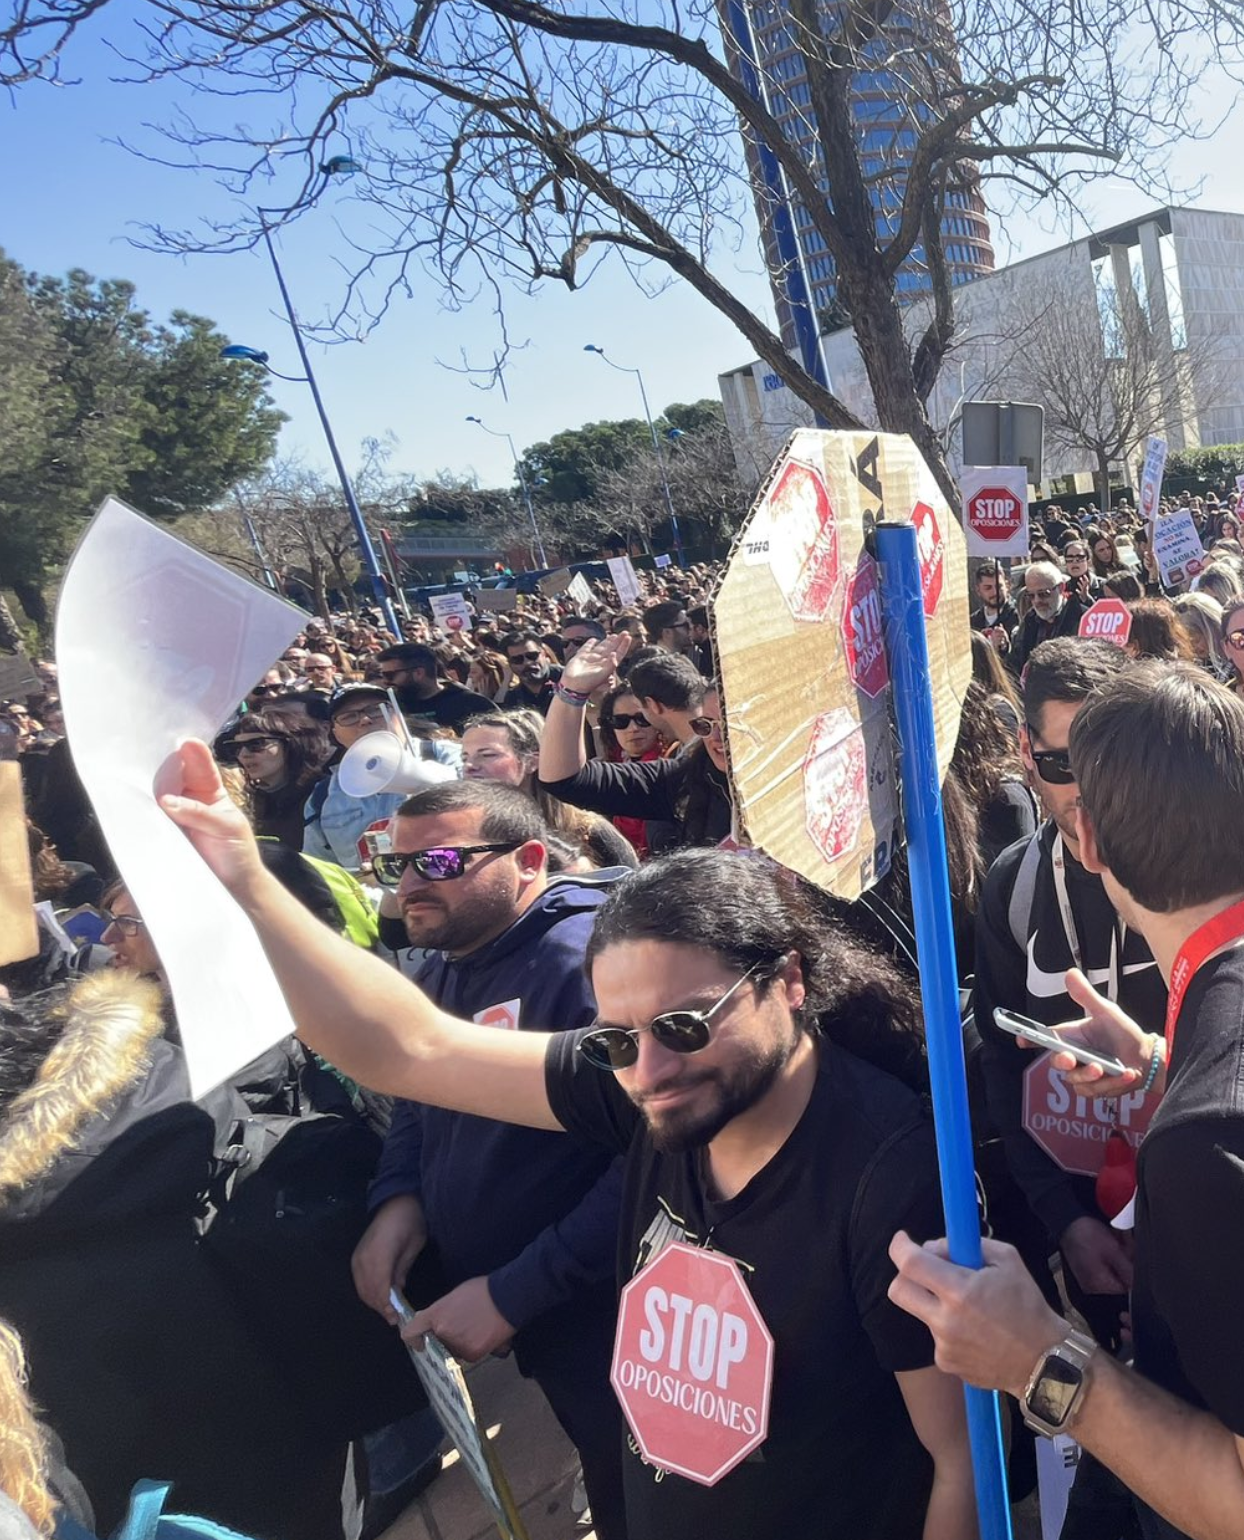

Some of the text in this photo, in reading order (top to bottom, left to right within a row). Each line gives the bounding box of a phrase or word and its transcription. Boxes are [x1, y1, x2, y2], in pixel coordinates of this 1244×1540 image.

[970, 518, 1021, 527] OPOSICIONES
[975, 499, 1015, 519] STOP
[850, 587, 882, 652] STO
[1086, 612, 1124, 634] STOP
[639, 1285, 748, 1391] STOP
[619, 1359, 758, 1435] OPOSICIONES
